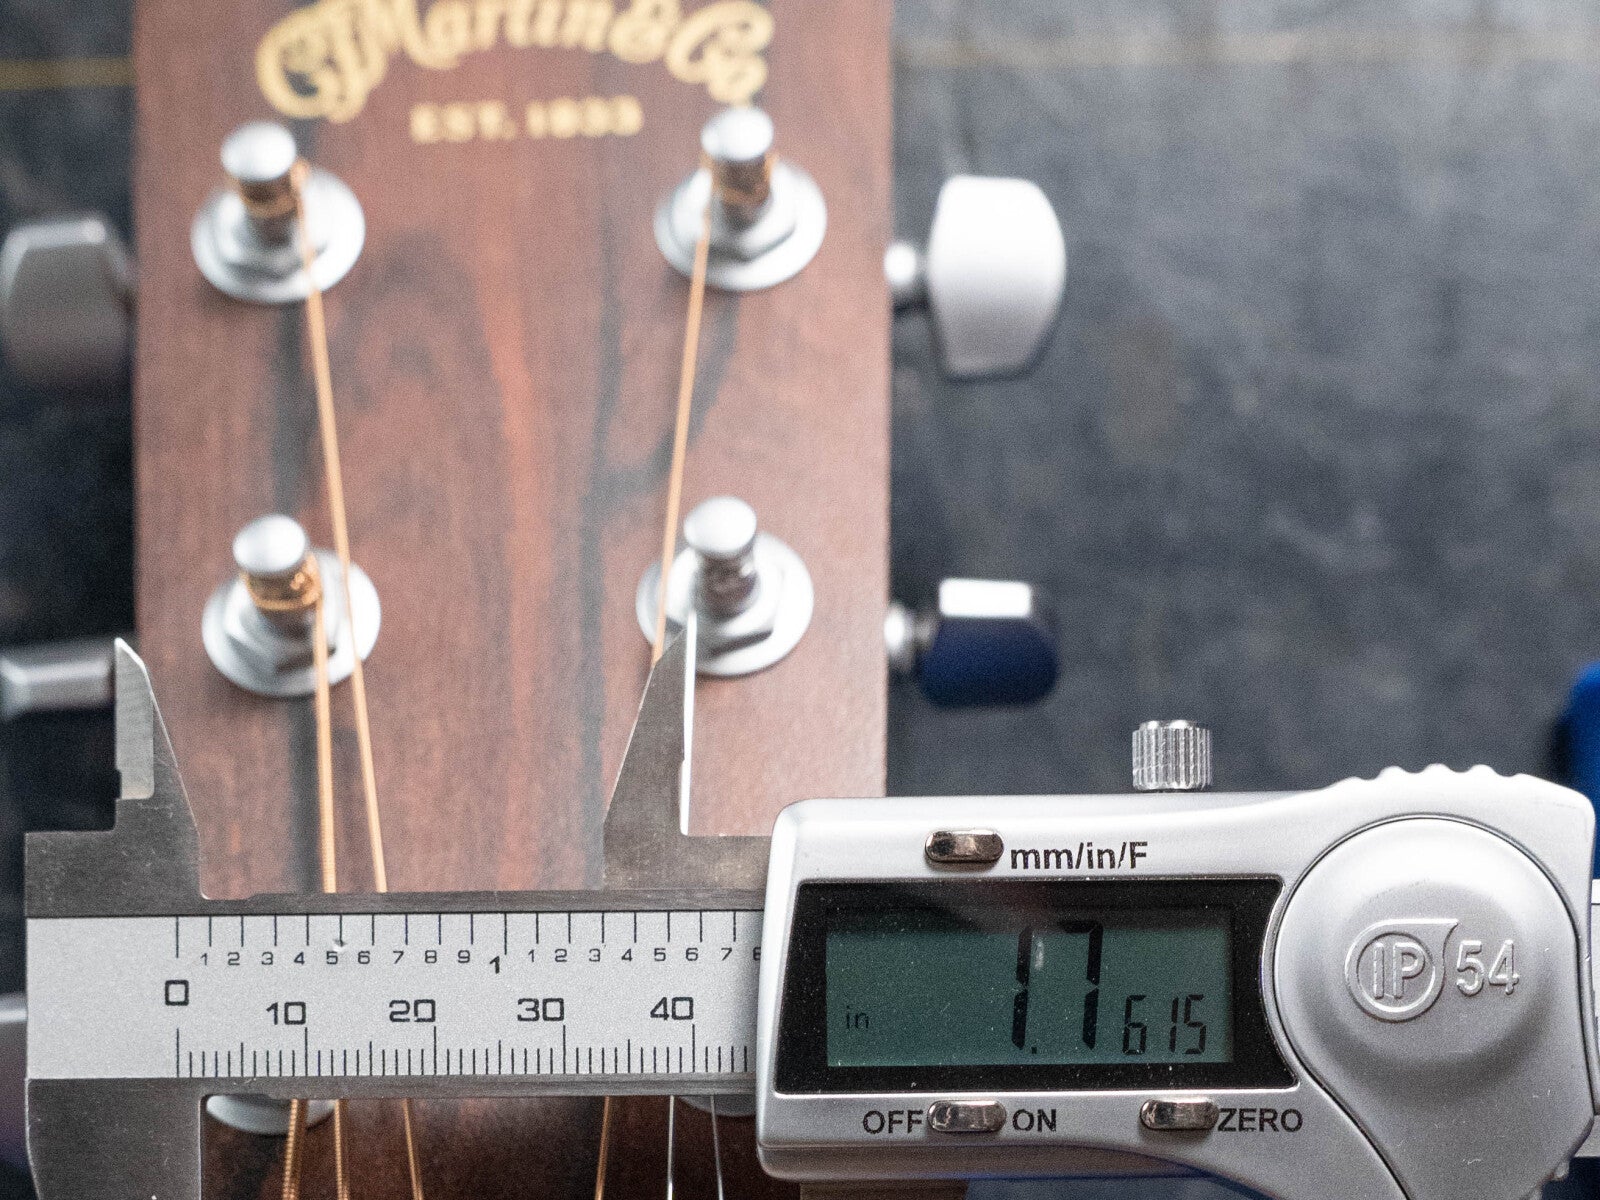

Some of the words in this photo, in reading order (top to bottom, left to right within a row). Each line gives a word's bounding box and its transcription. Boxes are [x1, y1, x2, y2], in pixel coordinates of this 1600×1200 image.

[1010, 841, 1149, 870] mm/in/F
[227, 951, 240, 966] 2
[261, 951, 274, 966] 3
[293, 950, 306, 965] 4
[326, 950, 339, 965] 5
[357, 950, 371, 965] 6
[392, 950, 404, 964] 7
[424, 950, 438, 964] 8
[457, 950, 471, 964] 9
[489, 955, 501, 974] 1
[554, 948, 568, 963] 2
[588, 948, 601, 962] 3
[621, 948, 633, 962] 4
[653, 947, 666, 962] 5
[685, 947, 699, 962] 6
[720, 947, 733, 961] 7
[1372, 942, 1427, 1000] IP
[1455, 940, 1521, 997] 54
[164, 979, 190, 1007] 0
[265, 1001, 307, 1026] 10
[388, 999, 436, 1023] 20
[516, 997, 565, 1022] 30
[649, 996, 694, 1021] 40
[845, 1005, 870, 1029] in
[861, 1109, 925, 1135] OFF
[1012, 1108, 1058, 1133] ON
[1217, 1107, 1304, 1134] ZERO
